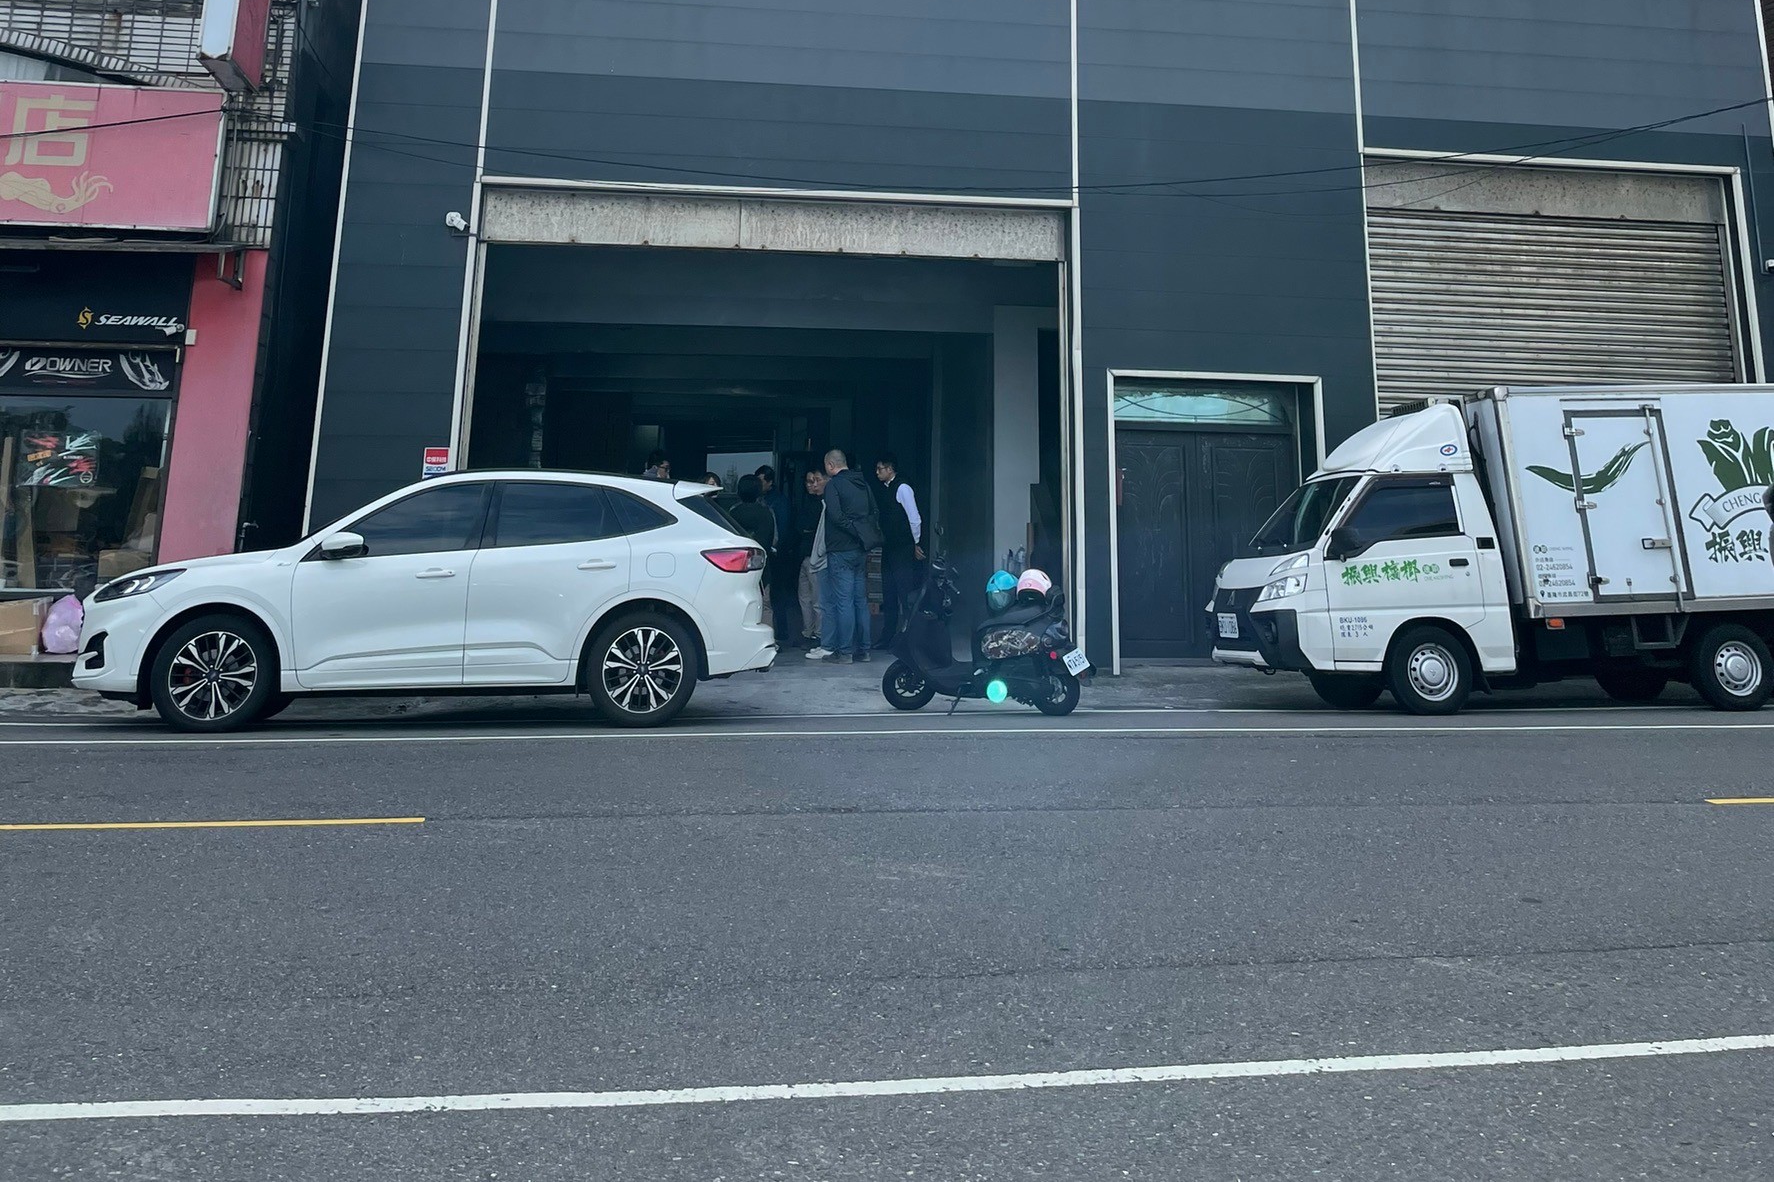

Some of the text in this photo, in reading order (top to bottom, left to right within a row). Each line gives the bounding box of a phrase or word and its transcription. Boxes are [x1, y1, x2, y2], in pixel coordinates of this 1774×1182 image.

[4, 94, 97, 167] 店
[95, 314, 179, 326] SEAWALL
[46, 357, 112, 372] OWNER
[1722, 492, 1762, 513] CHENG
